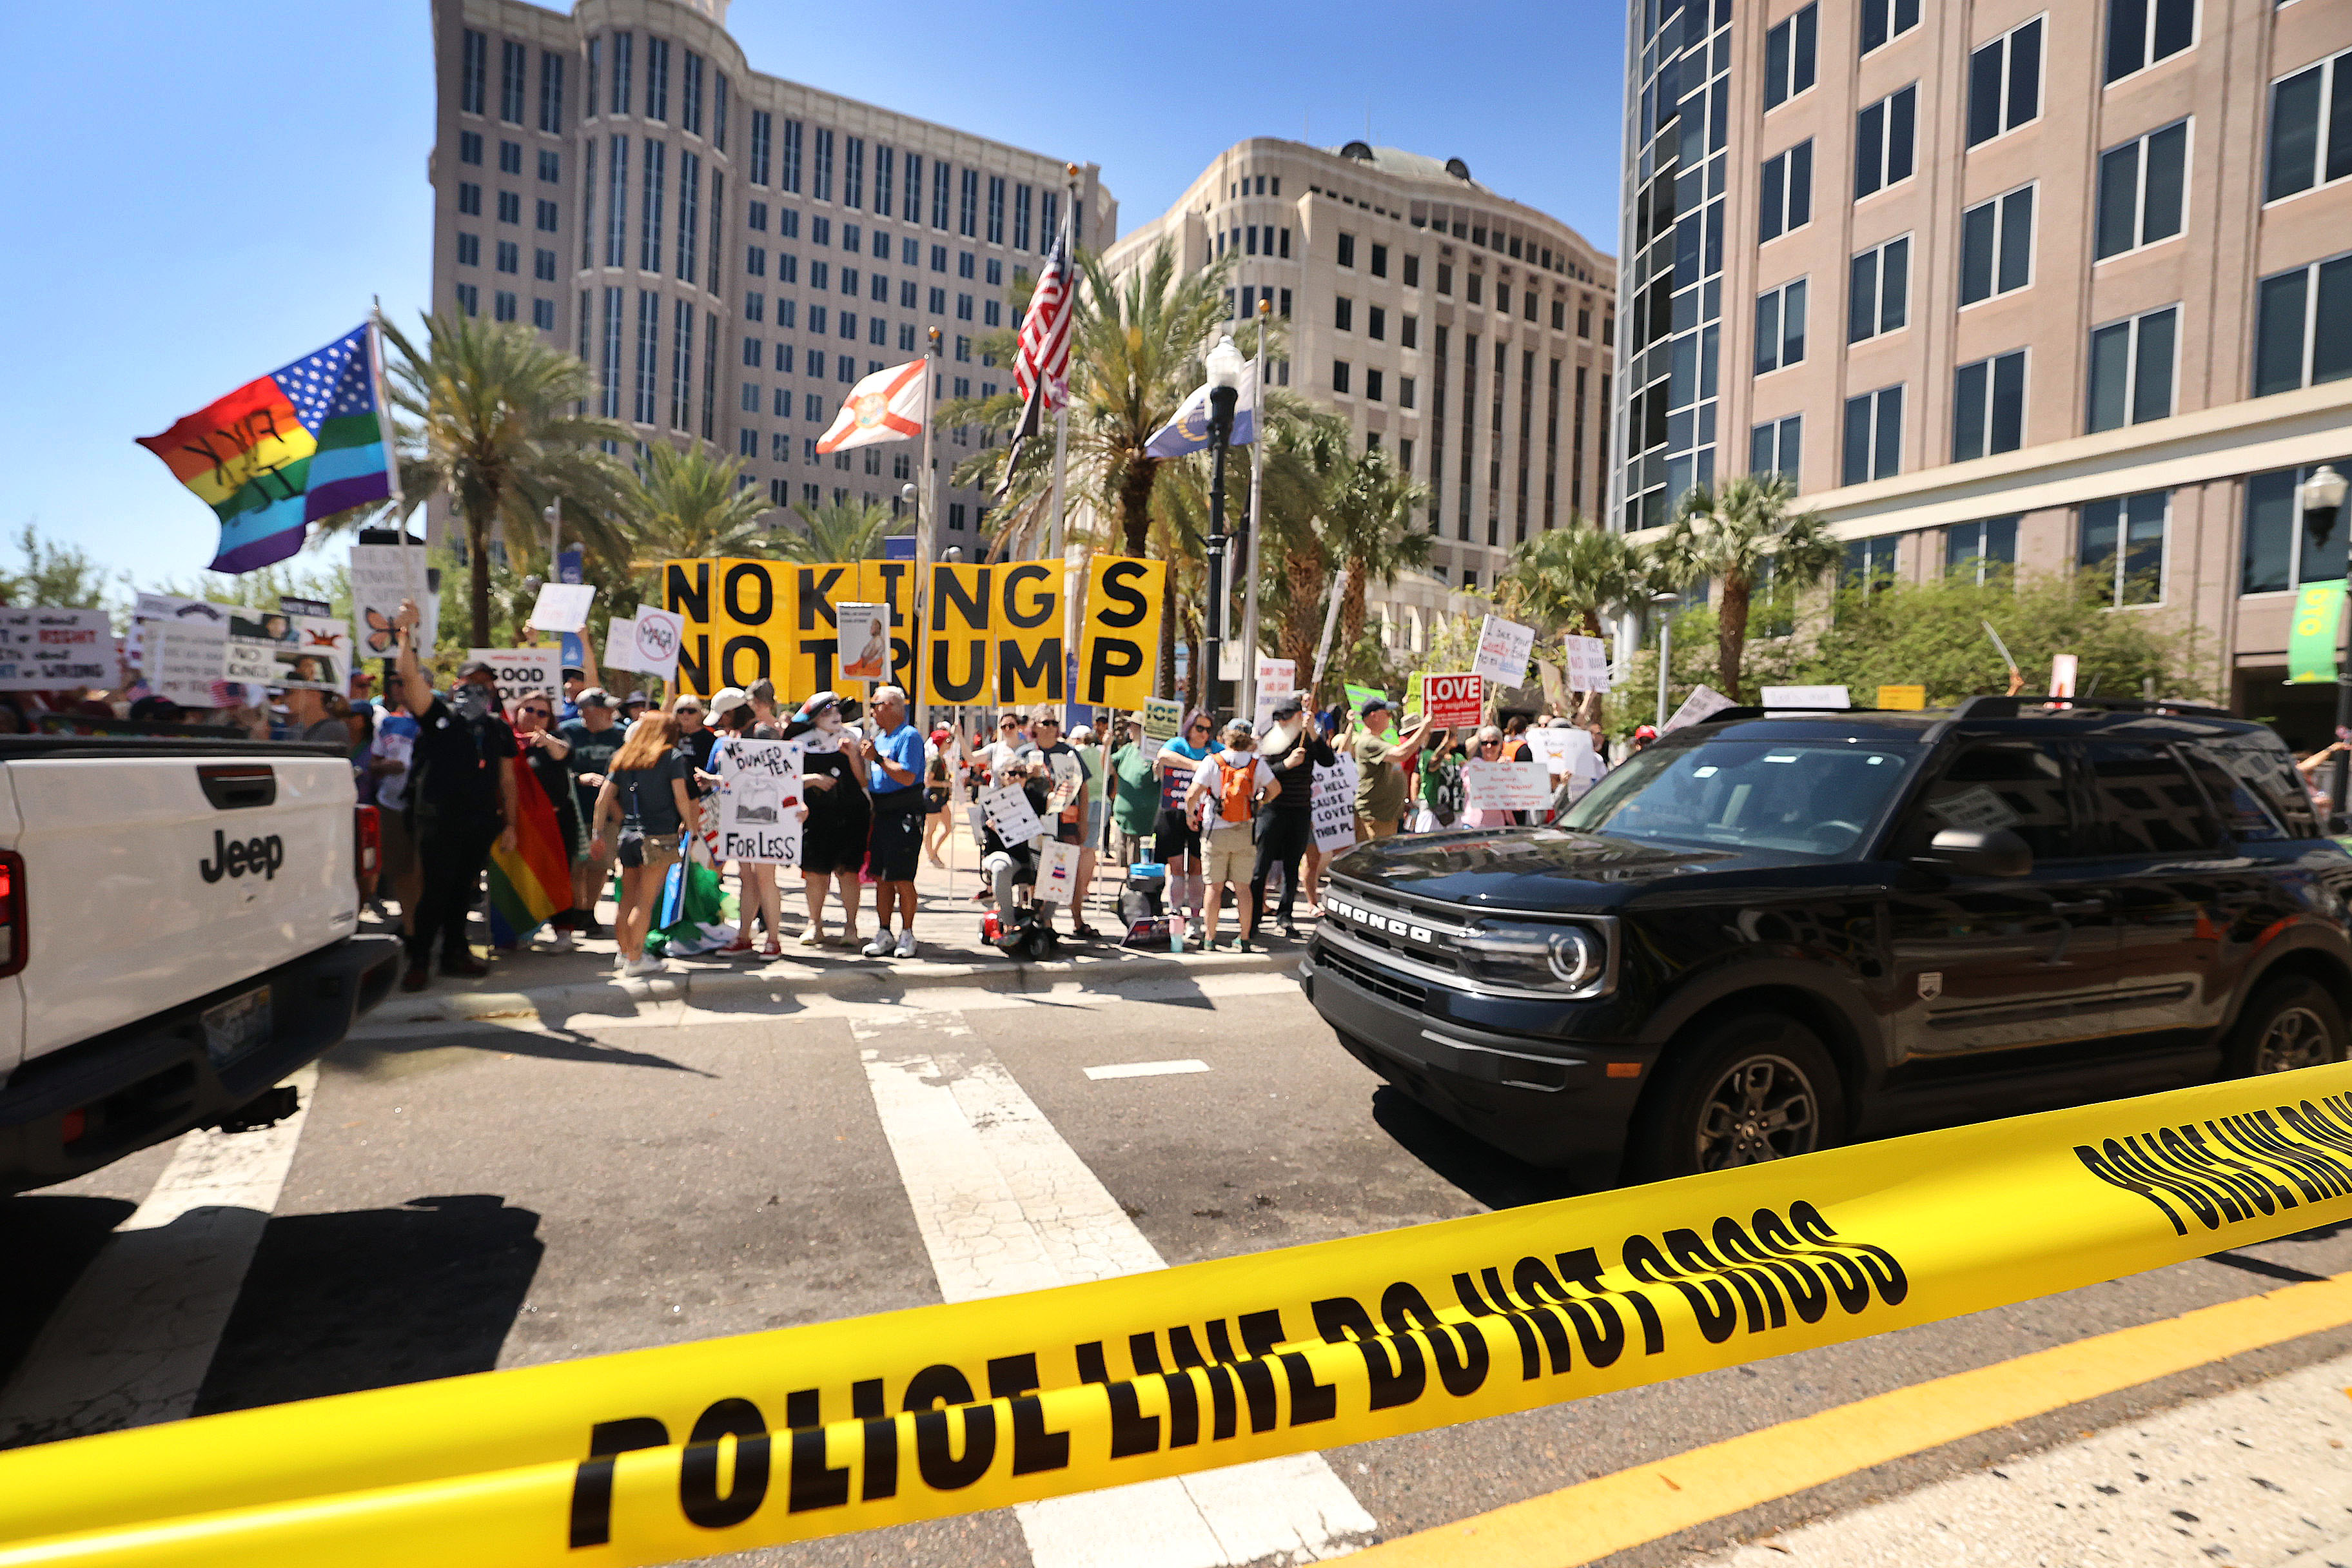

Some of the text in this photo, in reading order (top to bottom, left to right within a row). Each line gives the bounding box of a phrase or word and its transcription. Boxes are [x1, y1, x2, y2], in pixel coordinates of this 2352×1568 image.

[669, 561, 1148, 632] NO KINGS
[493, 668, 544, 682] OOD
[677, 635, 770, 696] NO
[799, 636, 1143, 703] TRUMP
[1425, 676, 1480, 701] LOVE
[763, 758, 792, 775] TEA
[199, 829, 283, 883] Jeep
[727, 830, 795, 859] FOR LESS
[1327, 897, 1433, 944] BRONCO
[2072, 1124, 2300, 1237] POLICE
[569, 1199, 1910, 1550] POLICE LINE DO NOT CROSS
